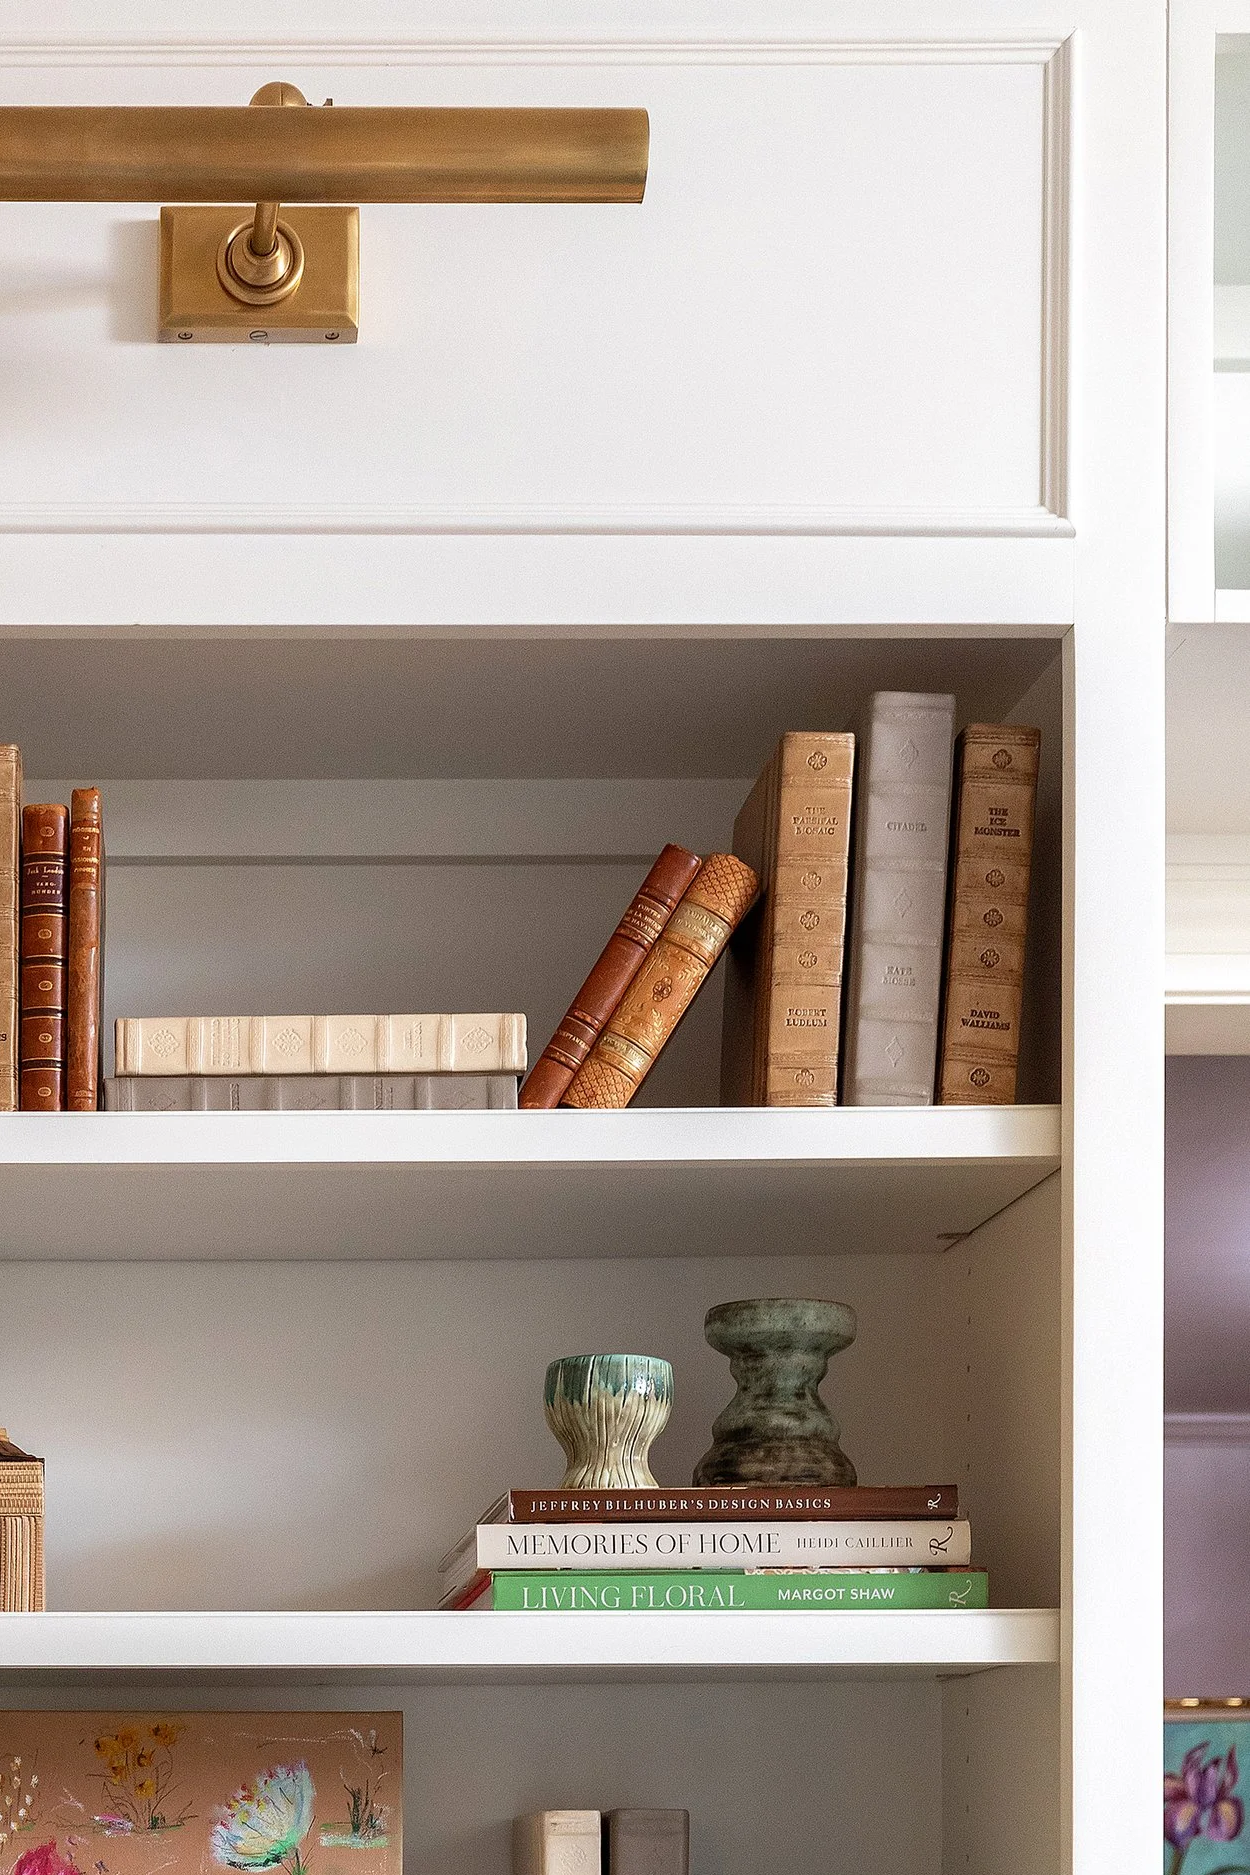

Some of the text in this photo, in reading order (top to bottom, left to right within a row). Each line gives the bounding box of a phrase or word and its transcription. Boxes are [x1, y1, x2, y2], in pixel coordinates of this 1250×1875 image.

[988, 807, 1009, 816] THE
[974, 826, 1021, 838] MONSTER
[788, 1008, 827, 1017] ROBERT
[970, 1009, 1000, 1019] DAVID
[530, 1497, 832, 1513] JEFFREY BILHUBER'S DESIGN BASICS
[506, 1532, 781, 1555] MEMORIES OF HOME
[796, 1536, 914, 1549] HEIDI CAILLIER
[522, 1584, 746, 1609] LIVING FLORAL
[777, 1587, 896, 1601] MARGOT SHAW
